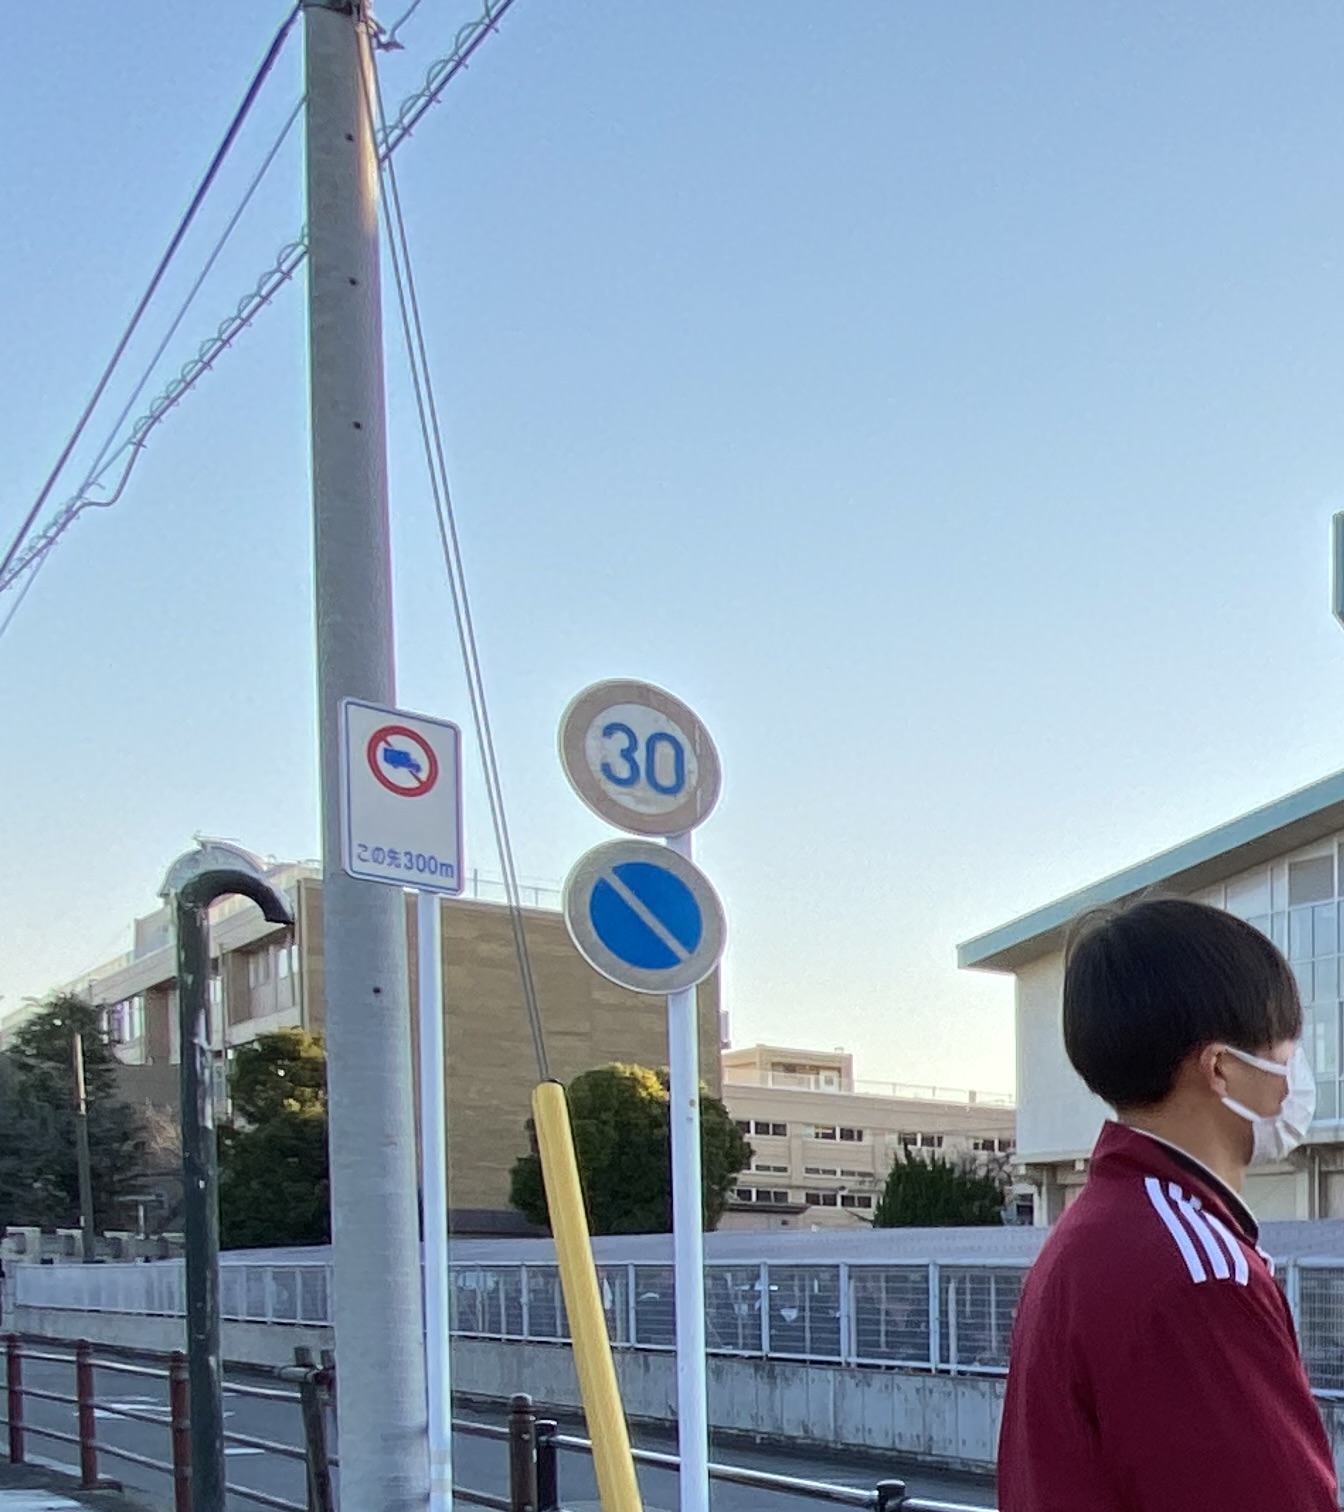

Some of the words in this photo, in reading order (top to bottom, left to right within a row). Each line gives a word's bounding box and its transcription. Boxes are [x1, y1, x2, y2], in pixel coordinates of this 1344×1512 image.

[601, 722, 685, 796] 30
[357, 842, 455, 879] この先300m
